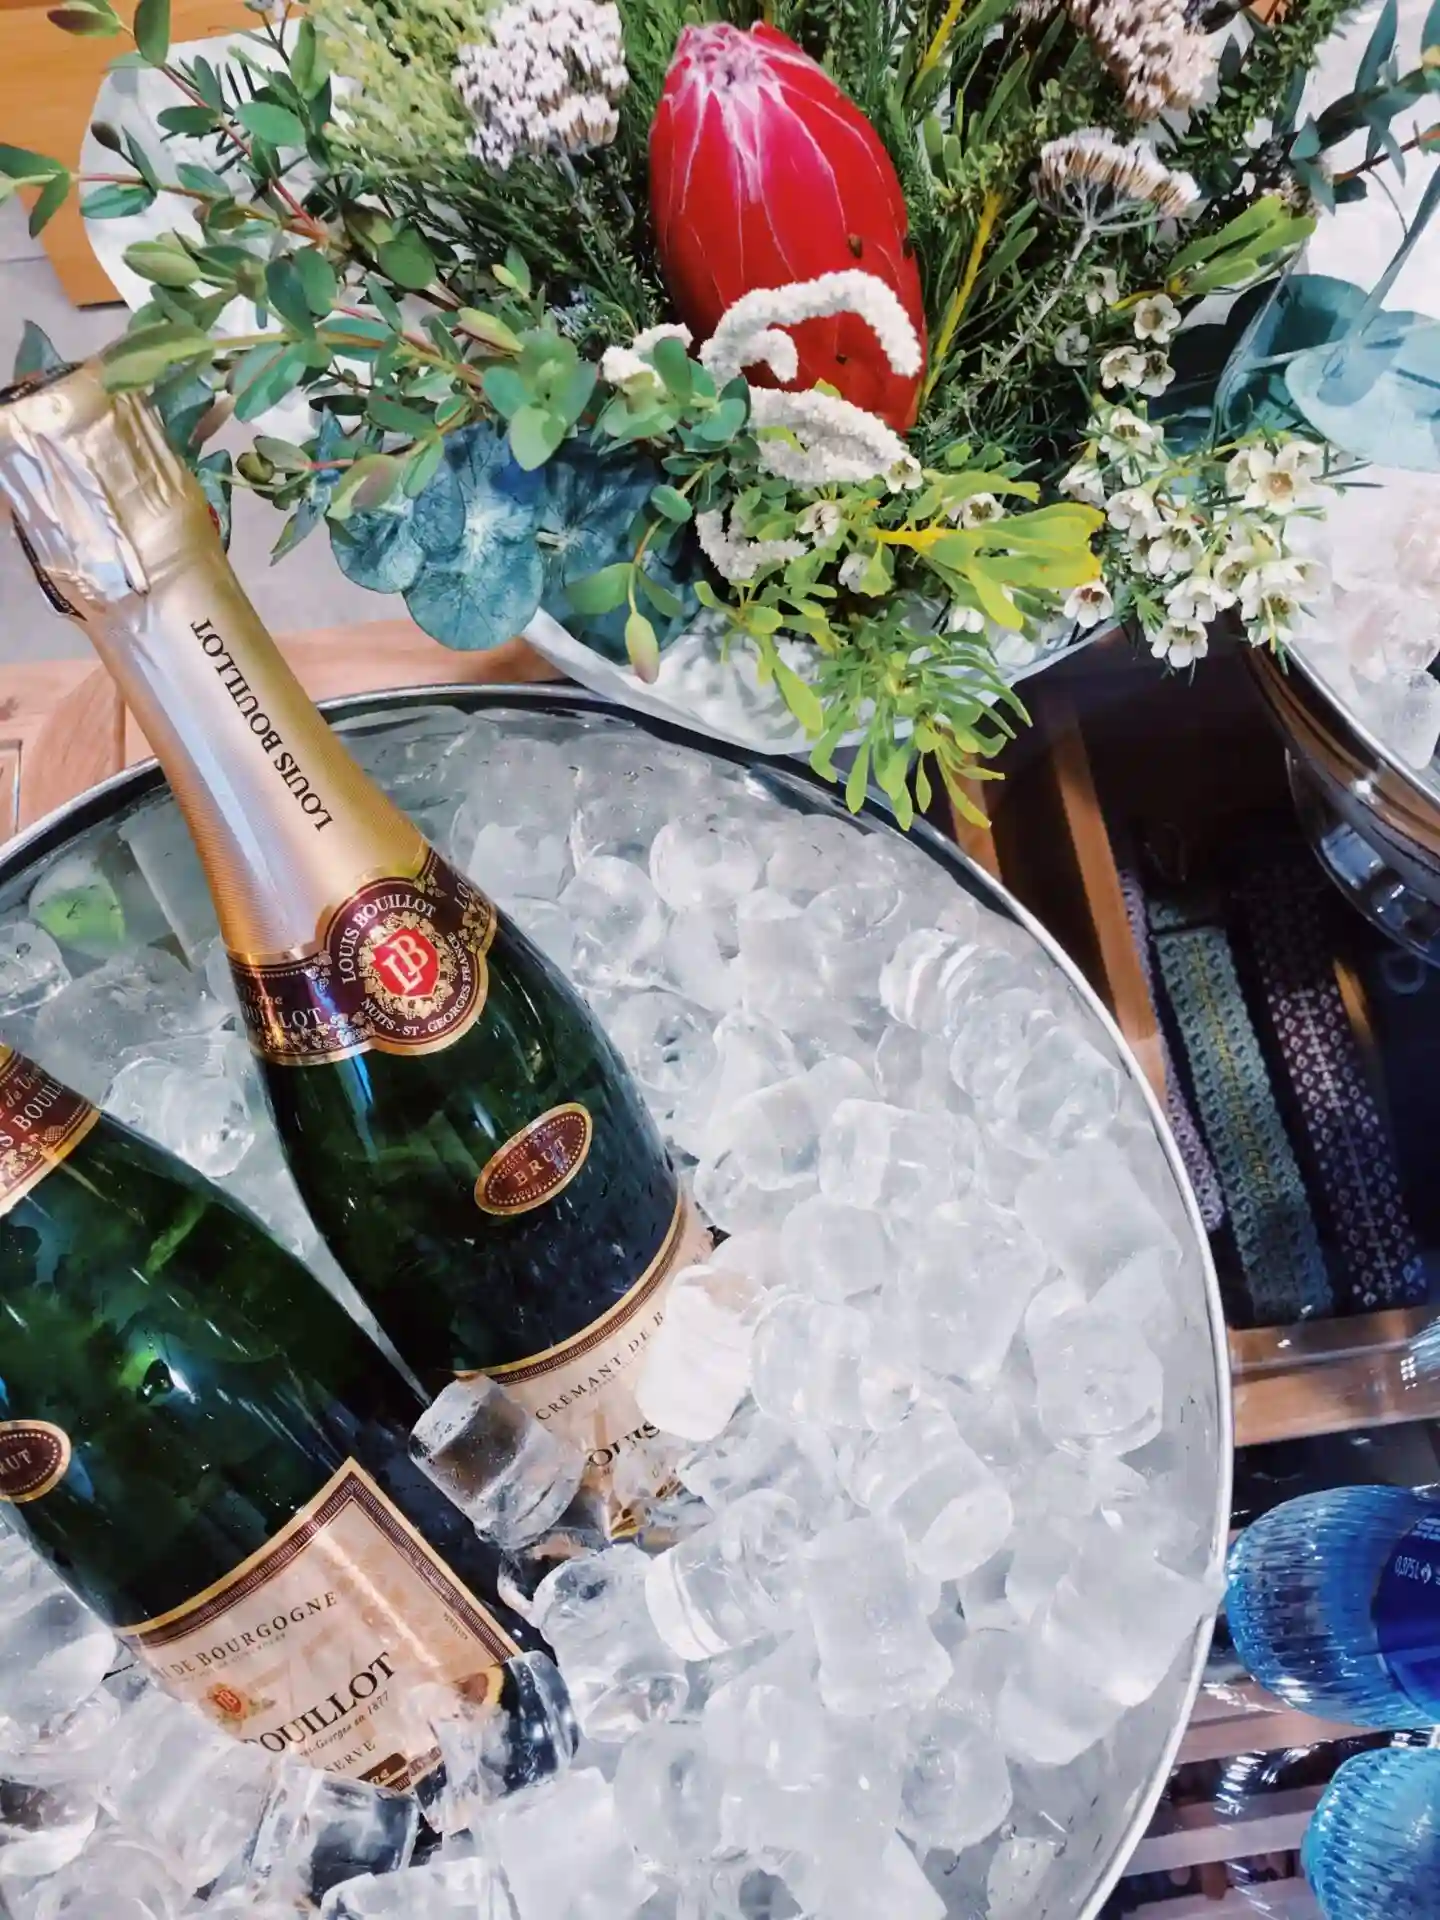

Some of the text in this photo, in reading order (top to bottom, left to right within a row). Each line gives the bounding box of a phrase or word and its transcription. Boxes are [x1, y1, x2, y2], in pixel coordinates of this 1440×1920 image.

[190, 617, 334, 832] LOUIS BOUILLOT
[338, 927, 361, 985] LOUIS
[352, 893, 437, 929] BOUILLOT
[360, 931, 472, 1037] NUITS ST GEORGES FRANCE
[513, 1136, 566, 1187] BRUT
[628, 1331, 651, 1354] DE
[170, 1659, 195, 1676] DE
[195, 1591, 338, 1667] BOURGOGNE
[242, 1651, 396, 1752] OUILLOT
[323, 1739, 376, 1773] SERVE
